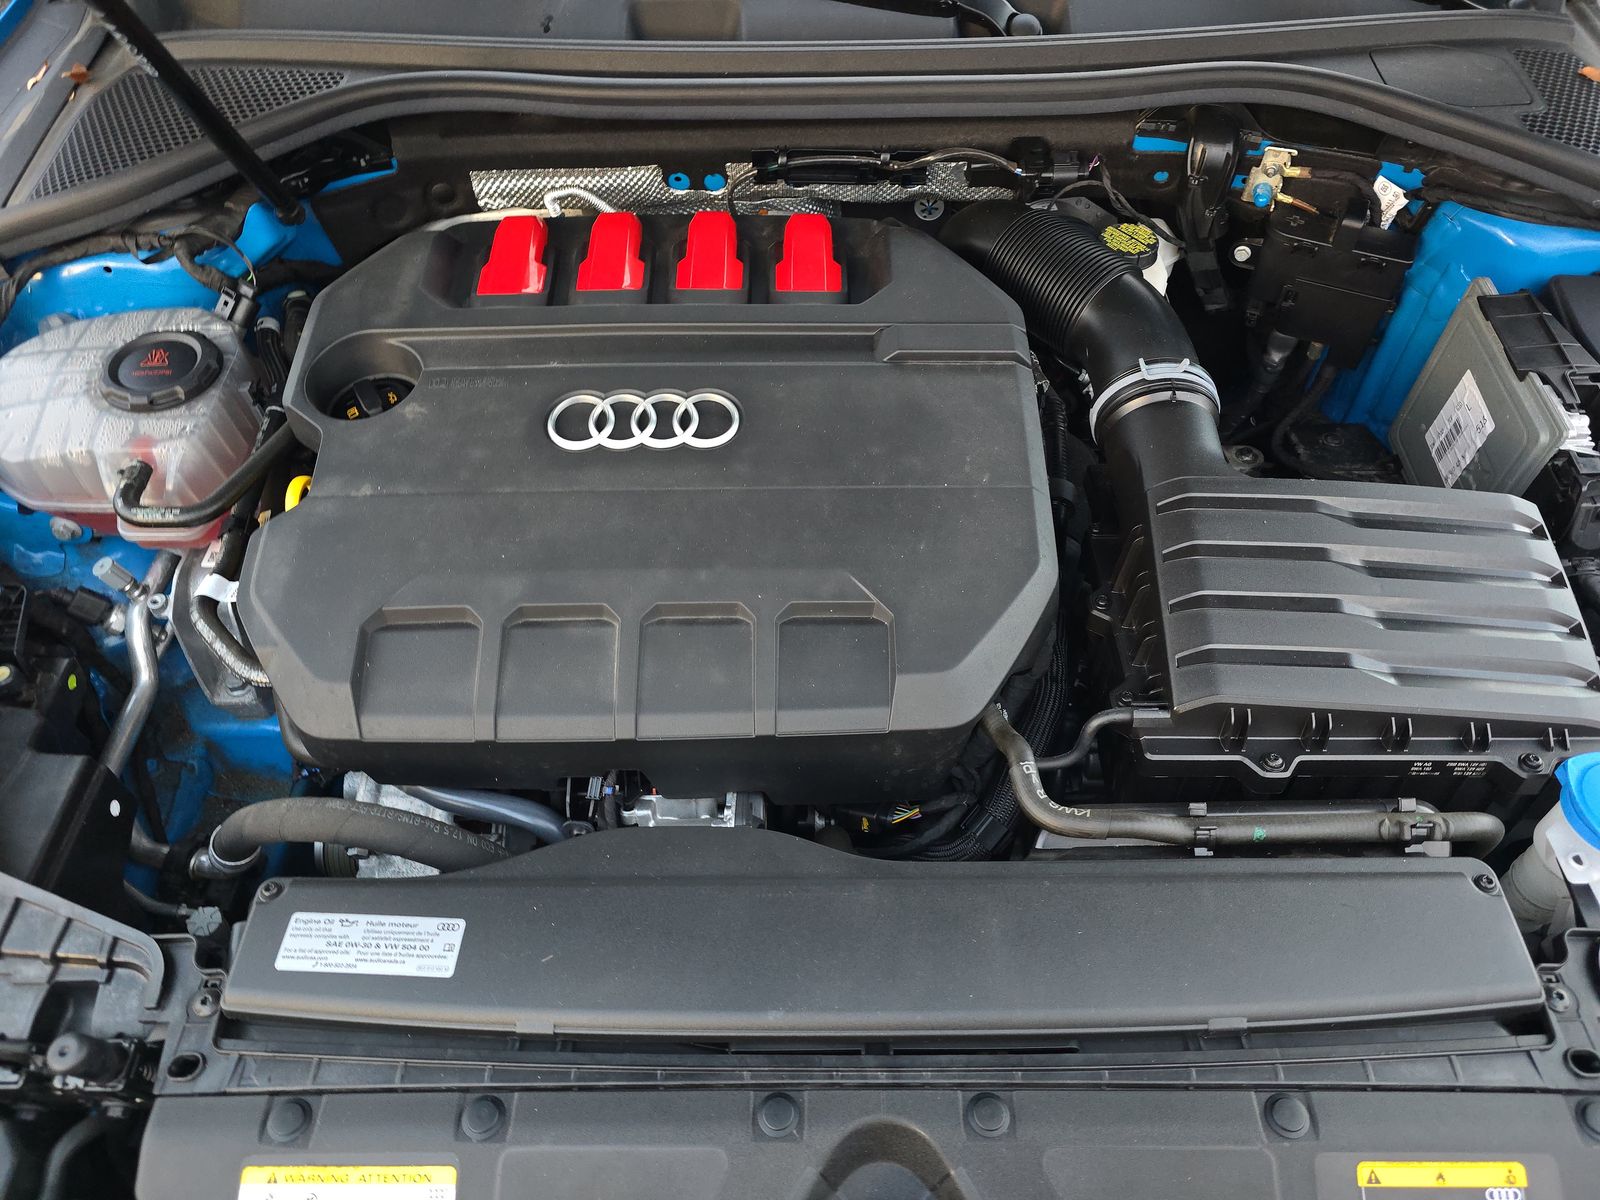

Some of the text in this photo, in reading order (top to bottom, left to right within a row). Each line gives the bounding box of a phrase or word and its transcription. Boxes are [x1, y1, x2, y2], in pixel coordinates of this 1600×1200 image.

[294, 917, 322, 926] Engine
[366, 920, 386, 928] Huile
[325, 940, 343, 949] SAE
[345, 941, 372, 950] 0W-30
[374, 942, 382, 950] &
[384, 943, 400, 951] VW
[418, 944, 430, 952] 00
[284, 1173, 433, 1184] WARNING ATTENTION
